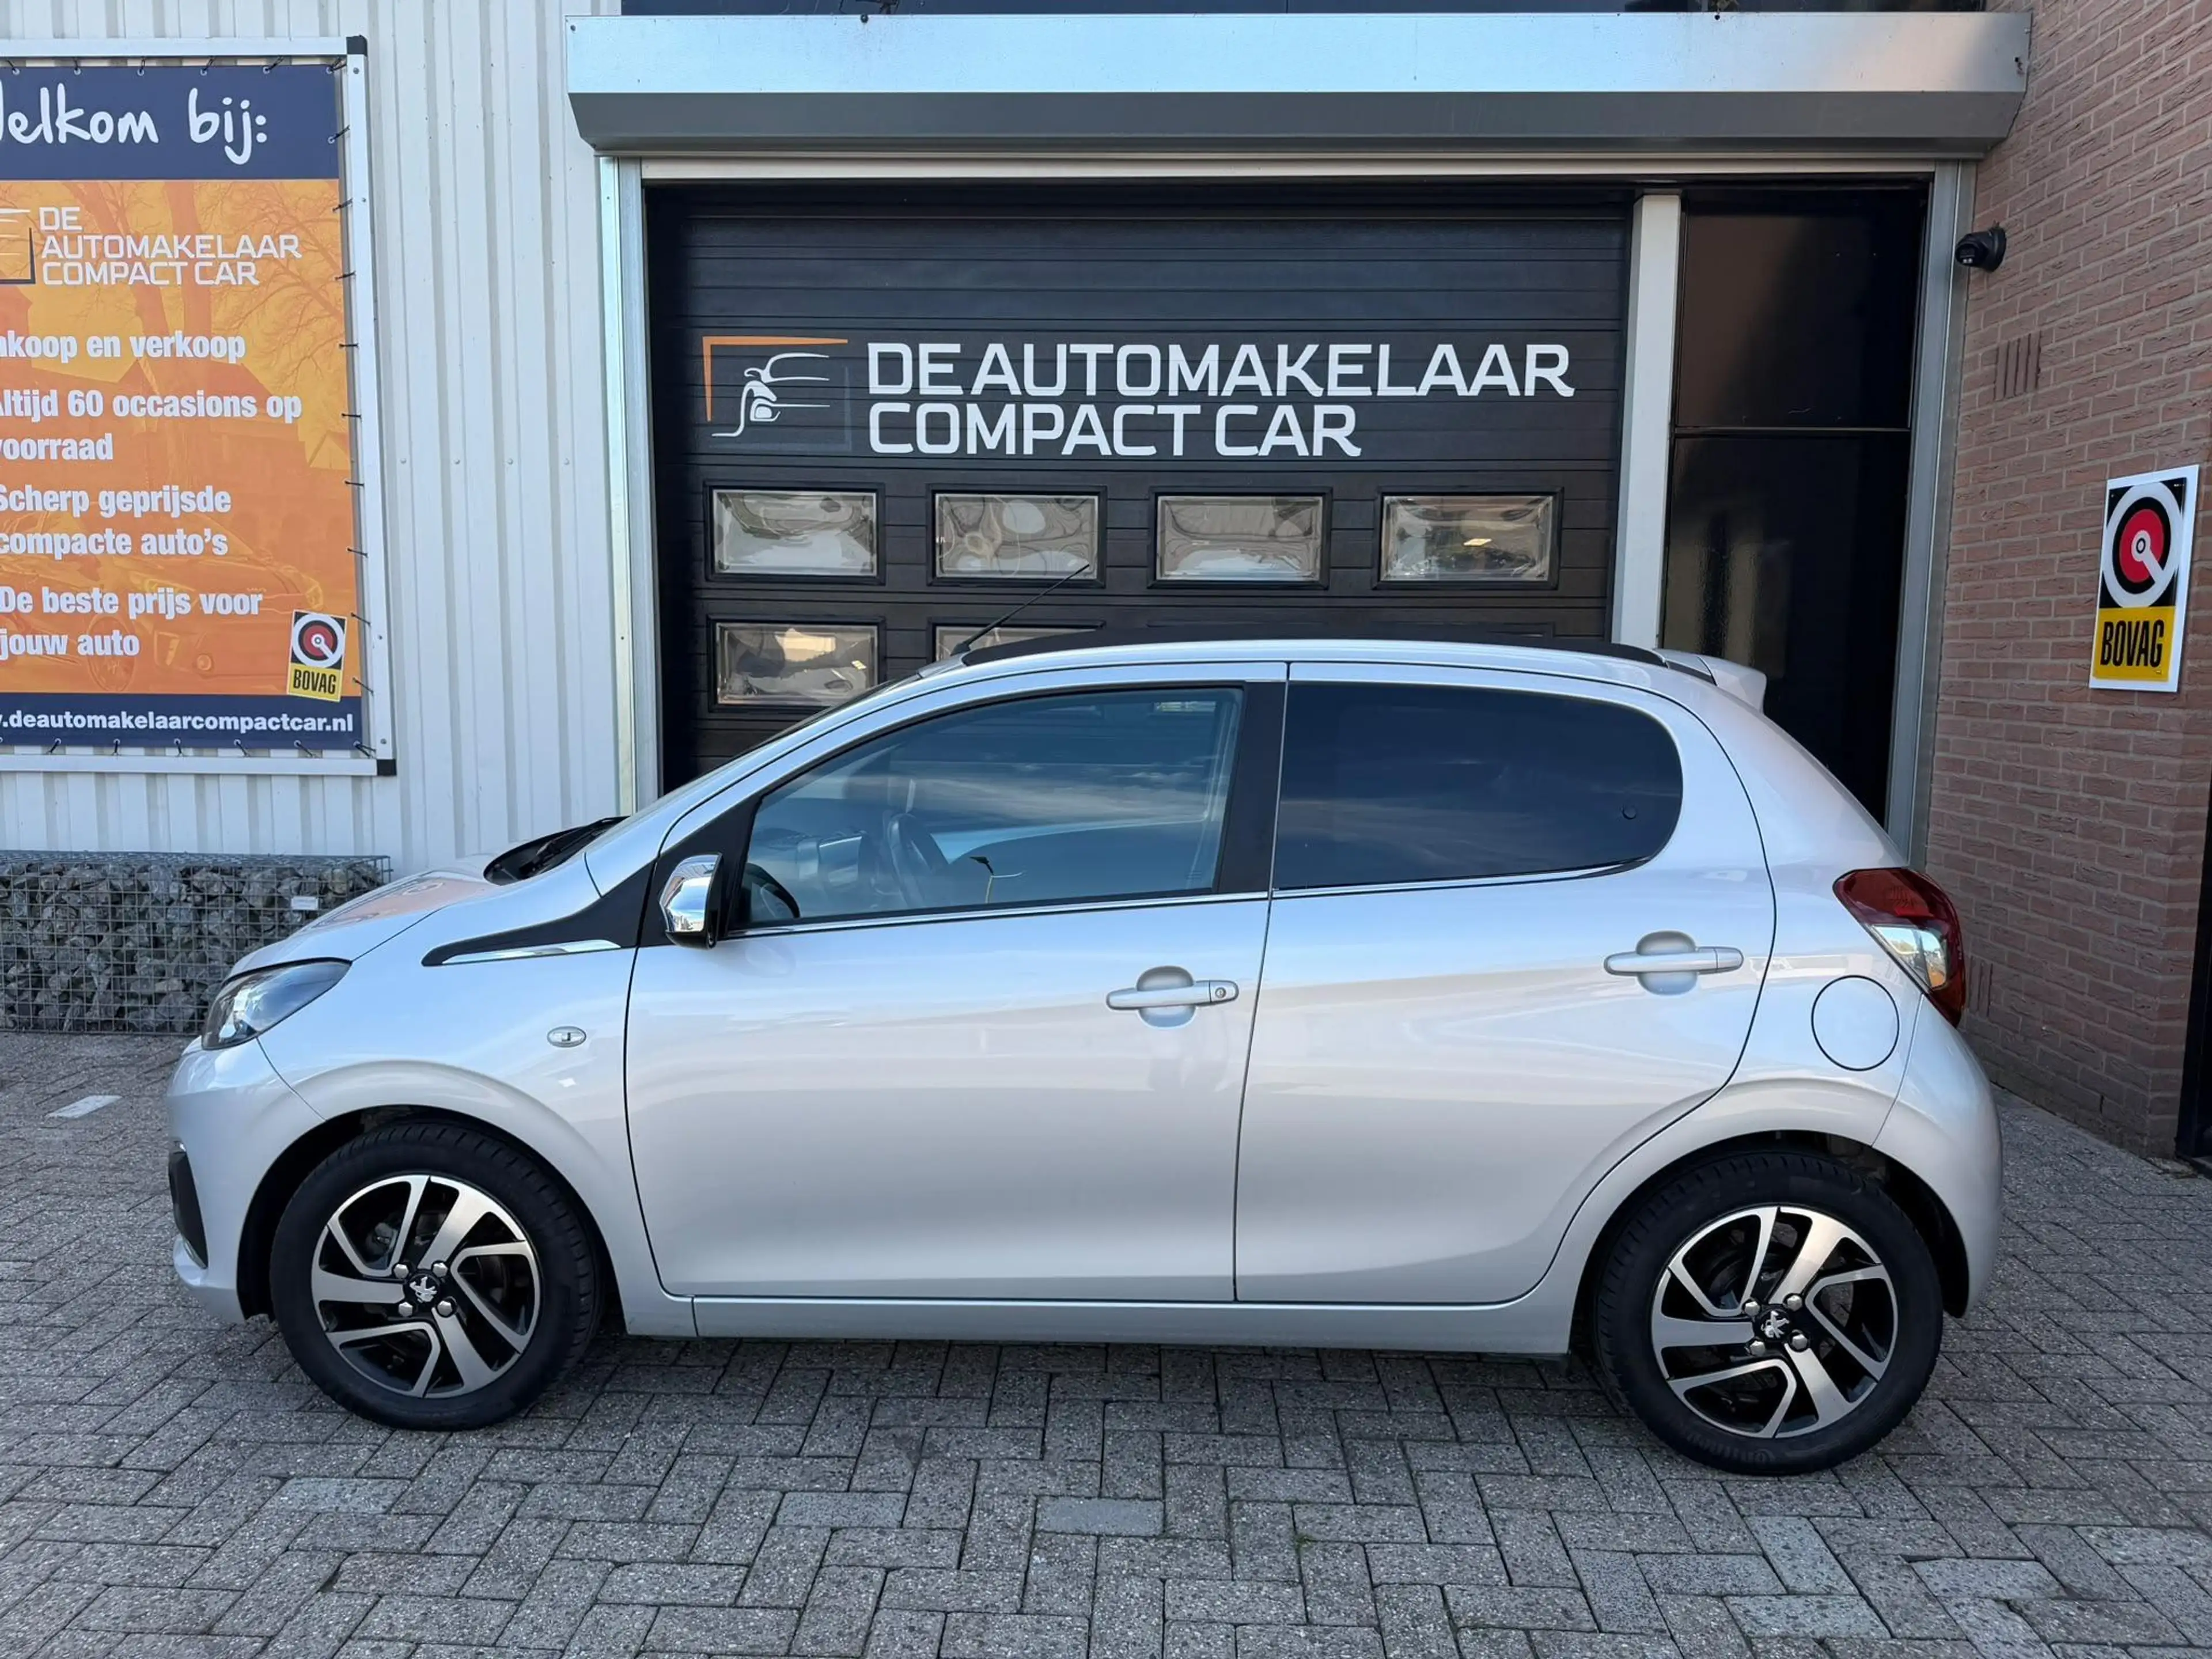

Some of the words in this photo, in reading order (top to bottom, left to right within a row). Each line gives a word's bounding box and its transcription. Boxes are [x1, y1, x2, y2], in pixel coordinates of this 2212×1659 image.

[0, 80, 158, 143] elkom
[188, 88, 267, 165] bij:
[39, 206, 82, 230] DE
[41, 234, 302, 259] AUTOMAKELAAR
[43, 262, 188, 286] COMPACT
[195, 262, 260, 286] CAR
[86, 335, 122, 358] en
[130, 330, 246, 364] verkoop
[868, 342, 963, 395] DE
[971, 343, 1575, 397] AUTOMAKELAAR
[0, 389, 59, 423] ltijd
[68, 389, 104, 416] 60
[113, 389, 257, 418] occasions
[267, 396, 302, 423] op
[869, 402, 1201, 457] COMPACT
[1215, 404, 1362, 457] CAR
[0, 433, 113, 460] oorraad
[99, 485, 232, 518] geprijsde
[0, 528, 131, 560] compacte
[0, 586, 33, 613] De
[42, 586, 119, 614] beste
[128, 588, 191, 619] prijs
[199, 593, 263, 615] voor
[0, 628, 69, 660] jouw
[78, 630, 139, 656] auto
[2100, 620, 2165, 668] BOVAG
[293, 669, 336, 695] BOVAG
[0, 710, 353, 732] .deautomakelaarcompactcar.nl
